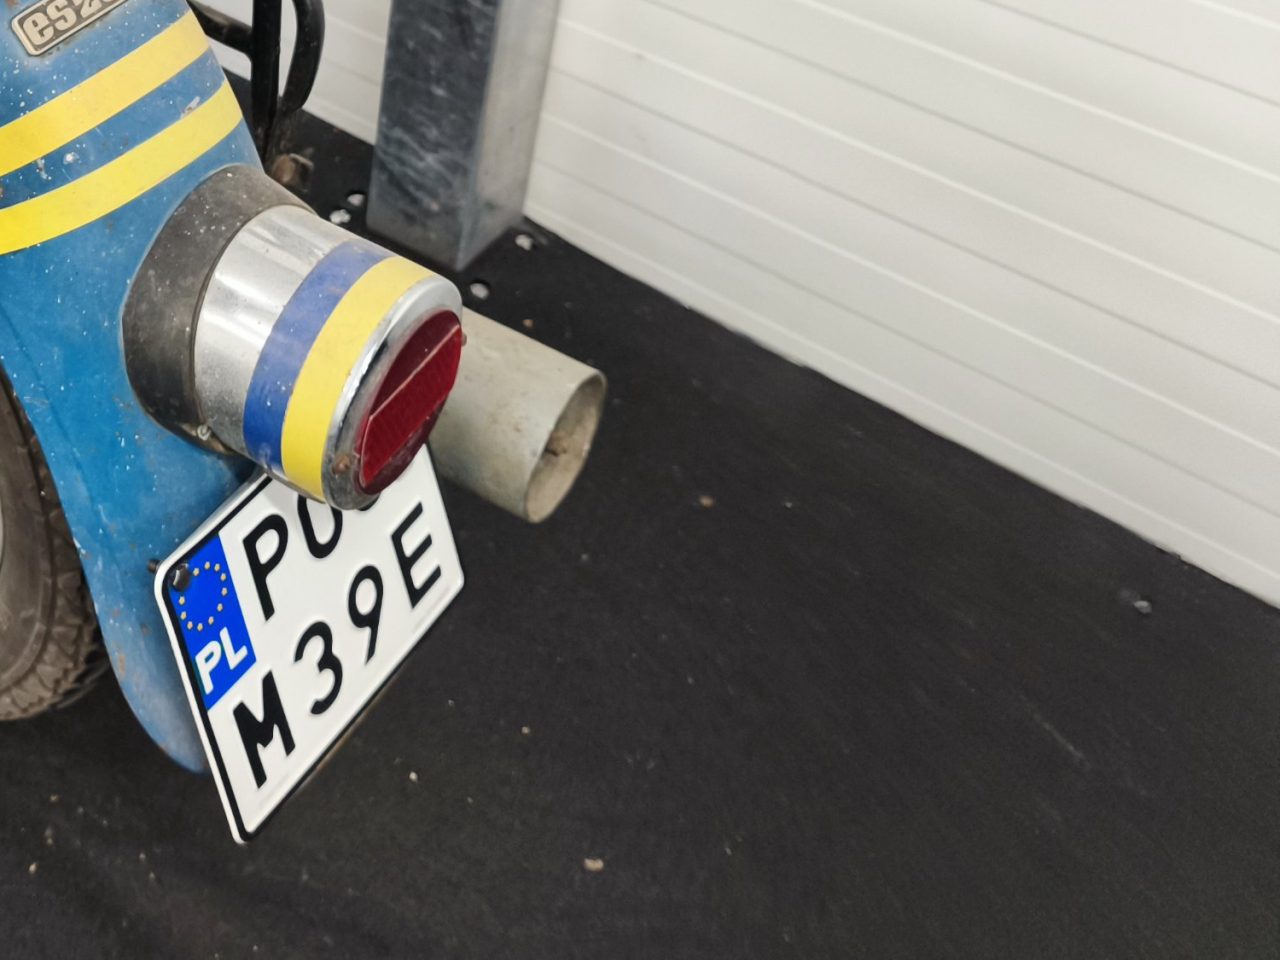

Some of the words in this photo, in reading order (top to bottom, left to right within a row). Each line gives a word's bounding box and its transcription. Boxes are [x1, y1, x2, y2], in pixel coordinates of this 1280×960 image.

[242, 492, 382, 622] PO
[194, 626, 248, 695] PL
[232, 501, 442, 790] M39E
